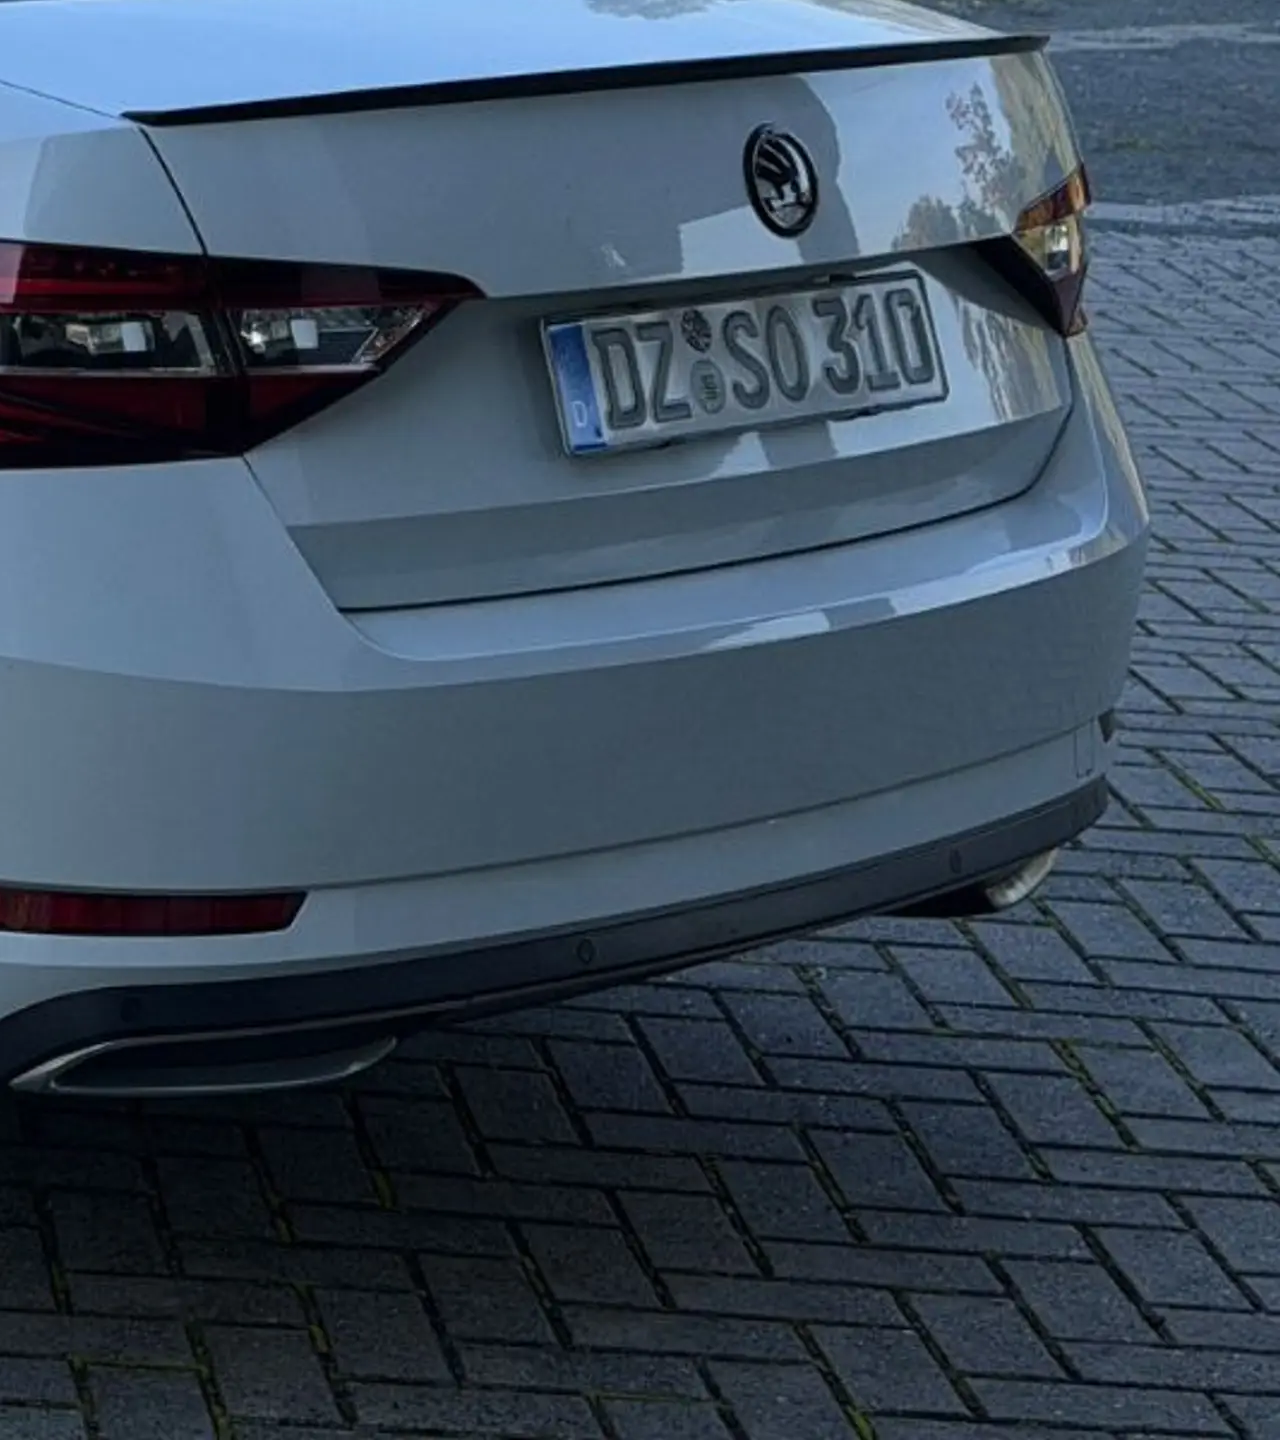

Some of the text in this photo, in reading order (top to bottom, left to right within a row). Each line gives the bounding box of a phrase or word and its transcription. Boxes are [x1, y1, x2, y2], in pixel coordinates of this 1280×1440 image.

[590, 288, 936, 430] DZ SO 310
[573, 401, 589, 428] D
